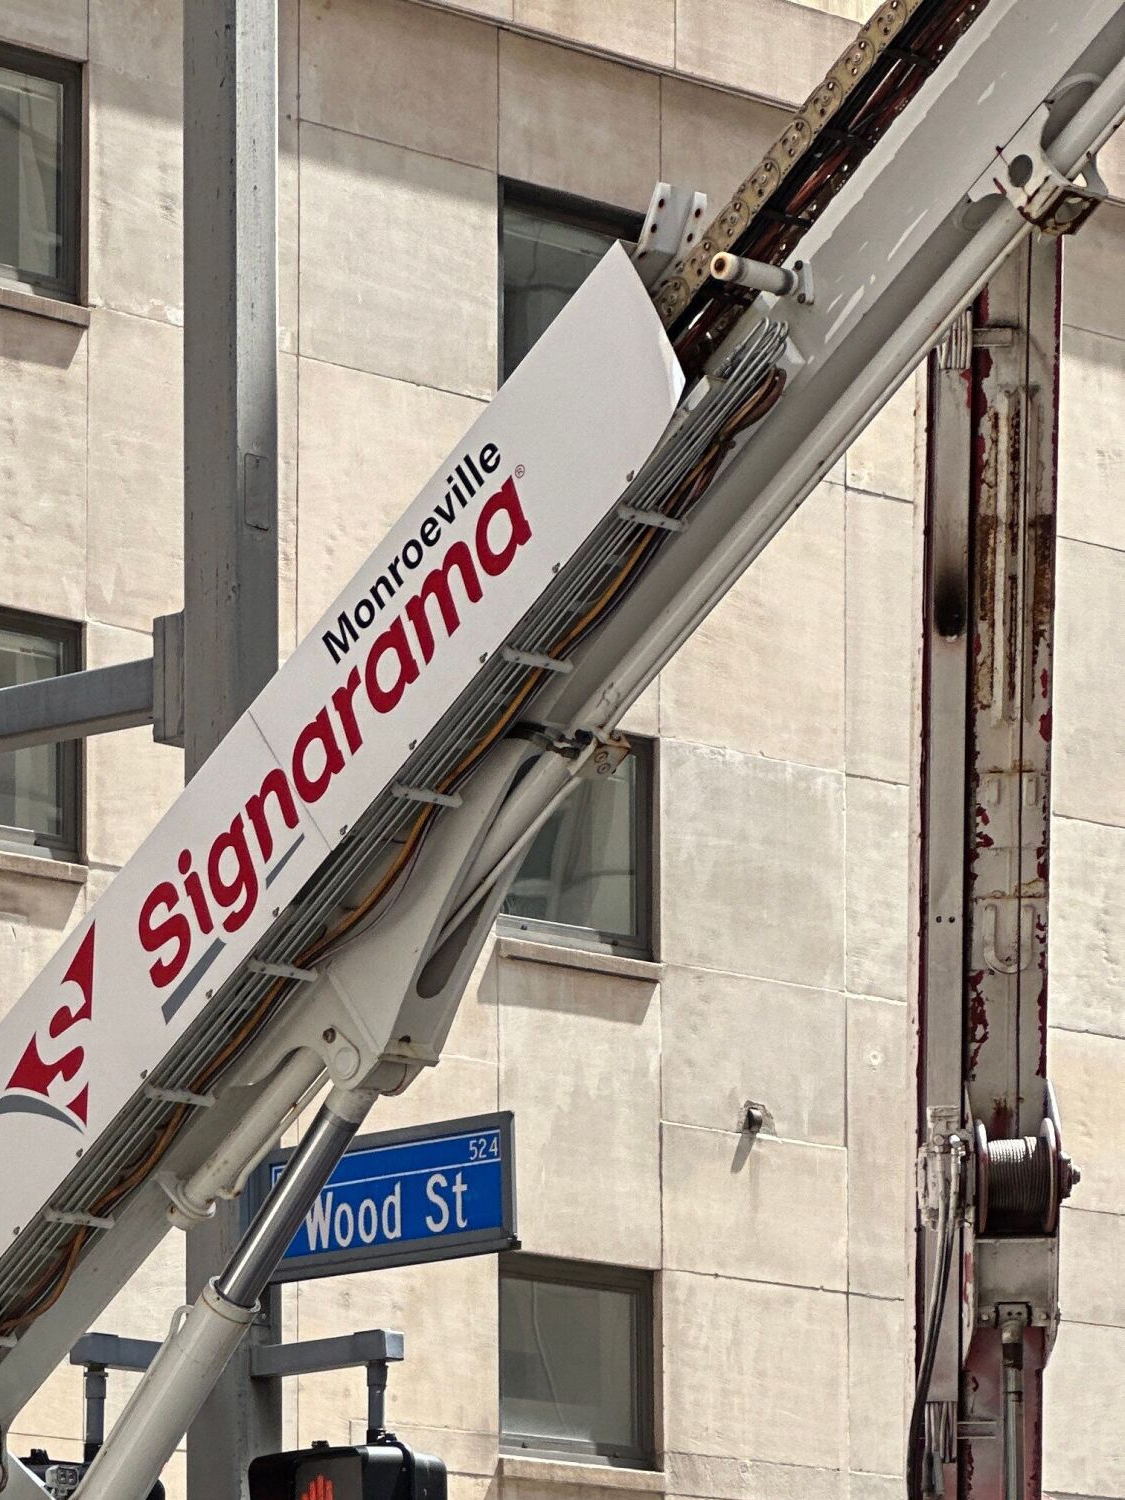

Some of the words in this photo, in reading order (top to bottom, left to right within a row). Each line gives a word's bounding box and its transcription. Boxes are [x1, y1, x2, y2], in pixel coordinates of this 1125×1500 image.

[321, 443, 501, 664] Monroeville
[138, 474, 533, 988] Signarama
[304, 1181, 402, 1251] Wood
[426, 1171, 468, 1233] St
[469, 1136, 499, 1161] 524
